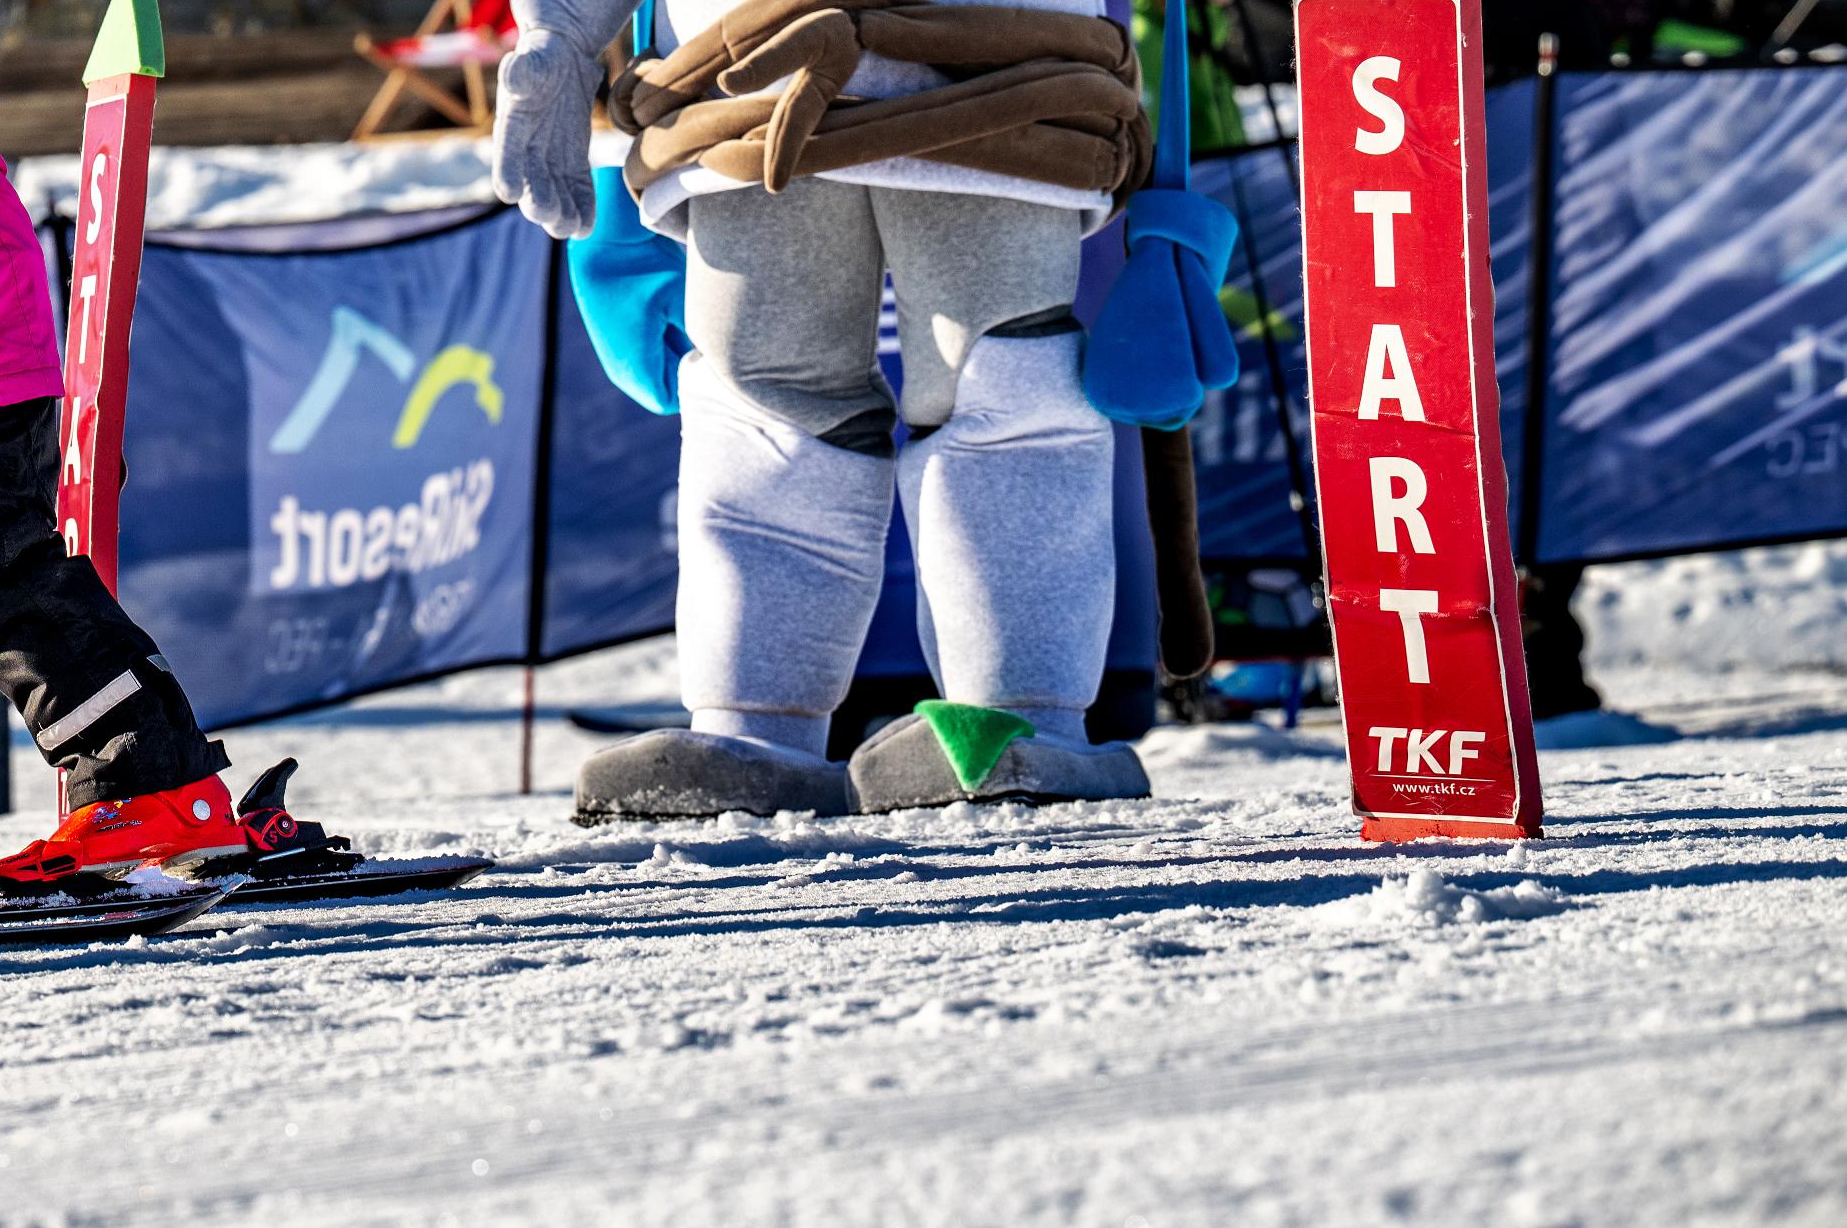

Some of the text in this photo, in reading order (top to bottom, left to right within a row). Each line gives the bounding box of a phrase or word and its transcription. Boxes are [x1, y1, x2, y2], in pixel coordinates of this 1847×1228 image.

[1352, 55, 1440, 684] START
[1368, 725, 1486, 775] TKF
[1392, 782, 1476, 796] www.tkf.cz
